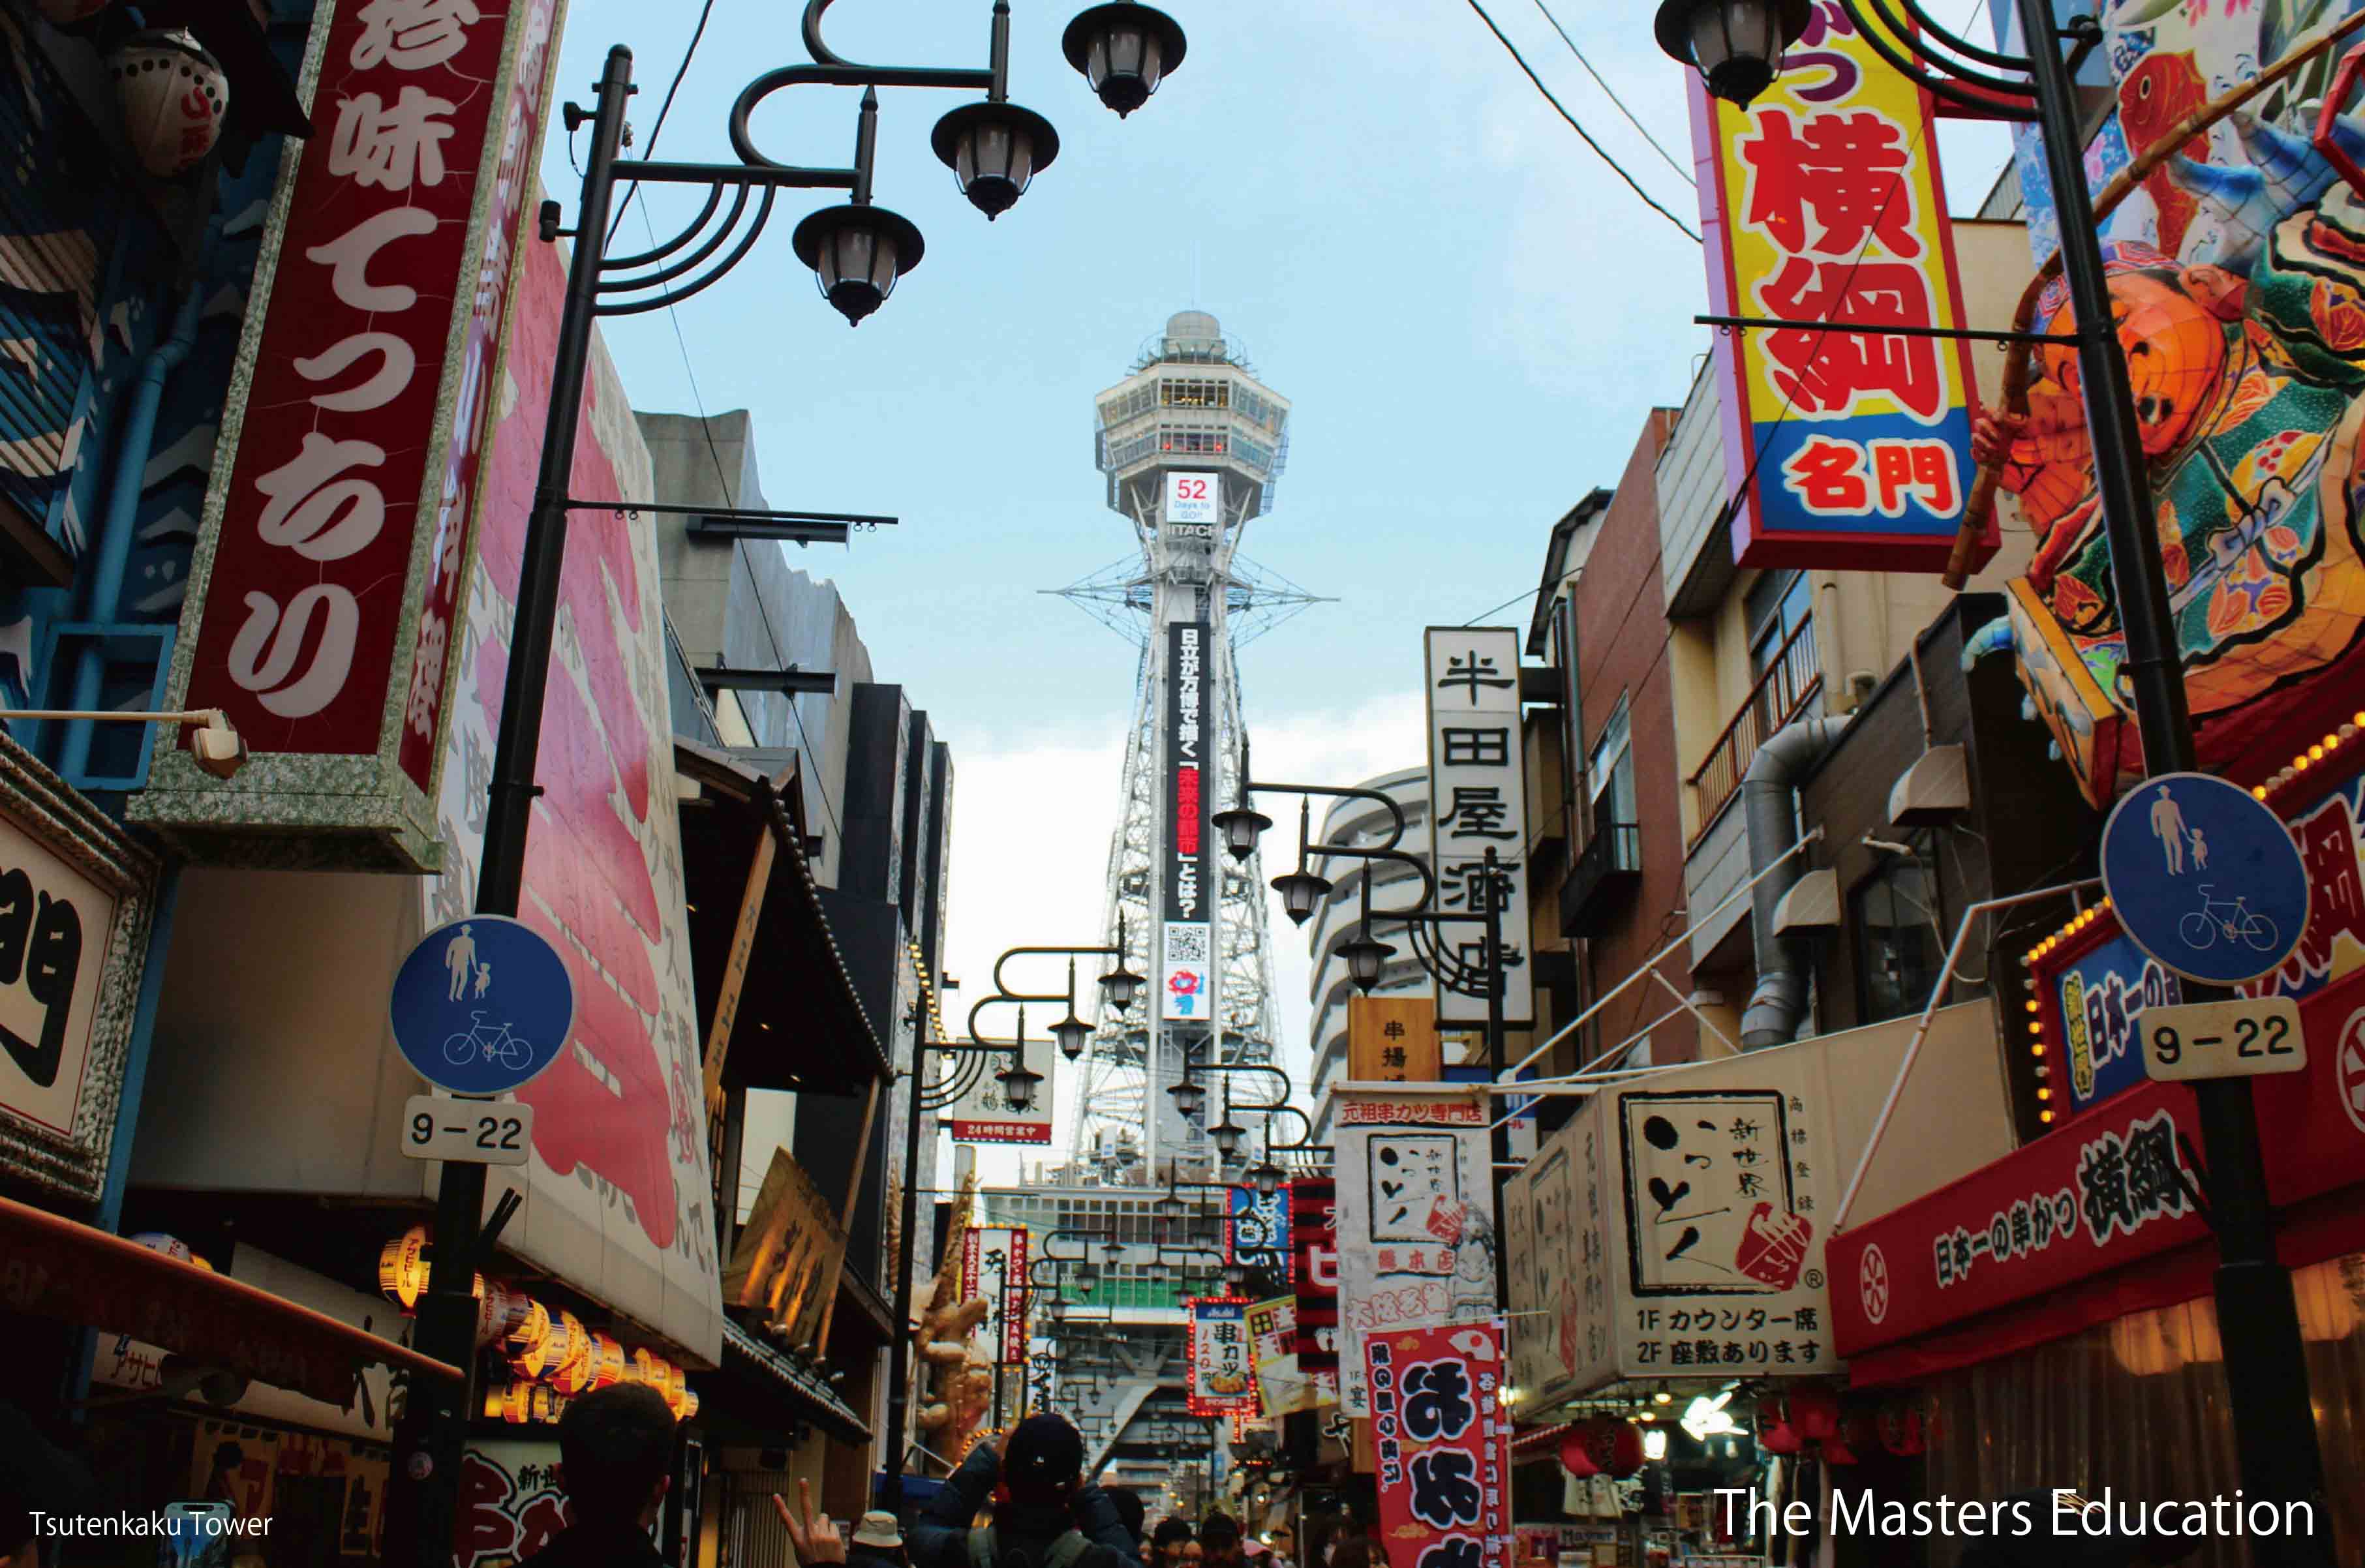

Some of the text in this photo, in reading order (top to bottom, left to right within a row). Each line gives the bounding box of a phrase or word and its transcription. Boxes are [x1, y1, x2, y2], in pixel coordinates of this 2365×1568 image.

[1743, 110, 1942, 418] 横綱
[1178, 479, 1207, 499] 52
[1789, 440, 1955, 513] 名門
[1383, 1021, 1407, 1082] 串揚
[1343, 1101, 1482, 1123] 元祖串カツ専門店
[1729, 1117, 1770, 1199] 新世界
[1935, 1190, 2076, 1285] 日本一の串かつ
[2080, 1113, 2196, 1244] 横綱
[1214, 1321, 1239, 1376] 串カツ
[1637, 1308, 1818, 1331] 1F カウンター席
[1637, 1341, 1662, 1363] 2F
